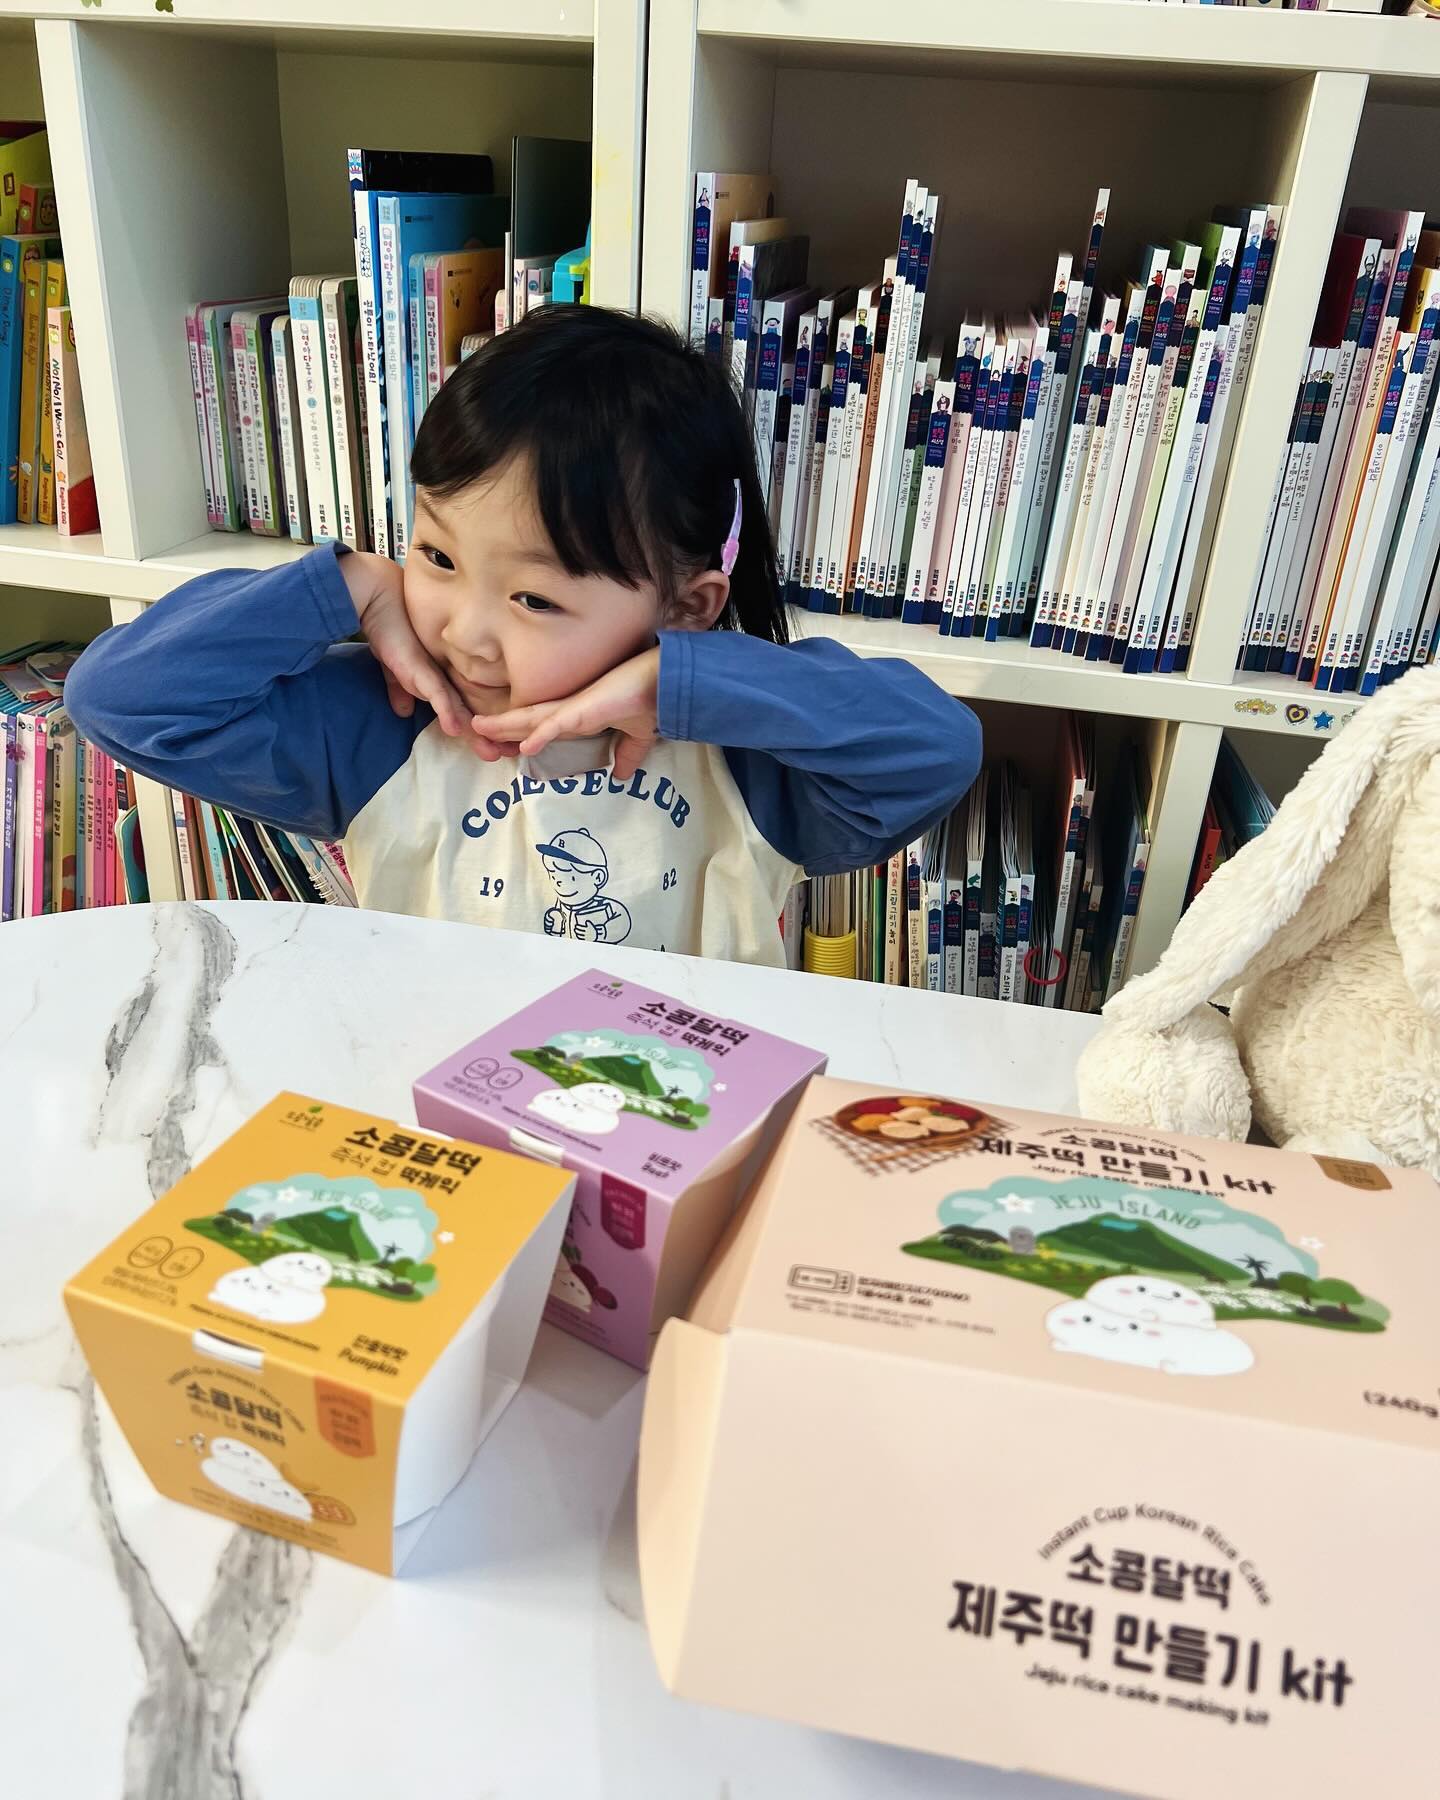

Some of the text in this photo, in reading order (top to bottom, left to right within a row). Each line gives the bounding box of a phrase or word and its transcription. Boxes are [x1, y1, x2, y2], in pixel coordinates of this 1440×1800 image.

[362, 300, 376, 384] 공룡이 나타났어요!
[52, 358, 60, 380] No!
[1128, 356, 1144, 390] 재미있는
[1188, 339, 1212, 399] 함께 나누어요
[1331, 350, 1351, 409] 모여라! ㄱㄴㄷ
[1369, 362, 1385, 391] 만나러
[52, 380, 62, 400] No!
[870, 394, 879, 407] 가장
[1157, 383, 1169, 398] 보는
[1365, 392, 1377, 409] 가요
[1122, 403, 1134, 429] 이야기
[1160, 396, 1179, 446] 자연의 친구들
[56, 440, 64, 460] Go!
[841, 439, 853, 459] 친구들
[1191, 432, 1202, 442] 내
[1187, 444, 1200, 462] 친구
[1038, 468, 1049, 482] 주지
[1062, 459, 1075, 492] 고맙습니다
[462, 768, 608, 838] COEGE
[558, 838, 566, 849] B
[480, 877, 504, 898] 19
[662, 868, 678, 892] 82
[638, 1002, 750, 1046] 소콩달떡
[681, 1032, 731, 1056] 떡케익
[345, 1126, 482, 1176] 소콩달떡
[1059, 1134, 1178, 1161] 소콩달떡
[331, 1146, 372, 1168] 즉석
[400, 1166, 461, 1194] 떡케익
[975, 1137, 1277, 1195] 제주떡 만들기 kit
[1051, 1193, 1202, 1230] JEJU ISLAND
[338, 1348, 399, 1377] Pumpkin
[1038, 1502, 1272, 1608] Instant Cup Korean Rice Cake
[1066, 1542, 1232, 1611] 소콩달떡
[947, 1580, 1354, 1708] 제주떡 만들기 kit
[1073, 1673, 1272, 1727] rice cake making kit
